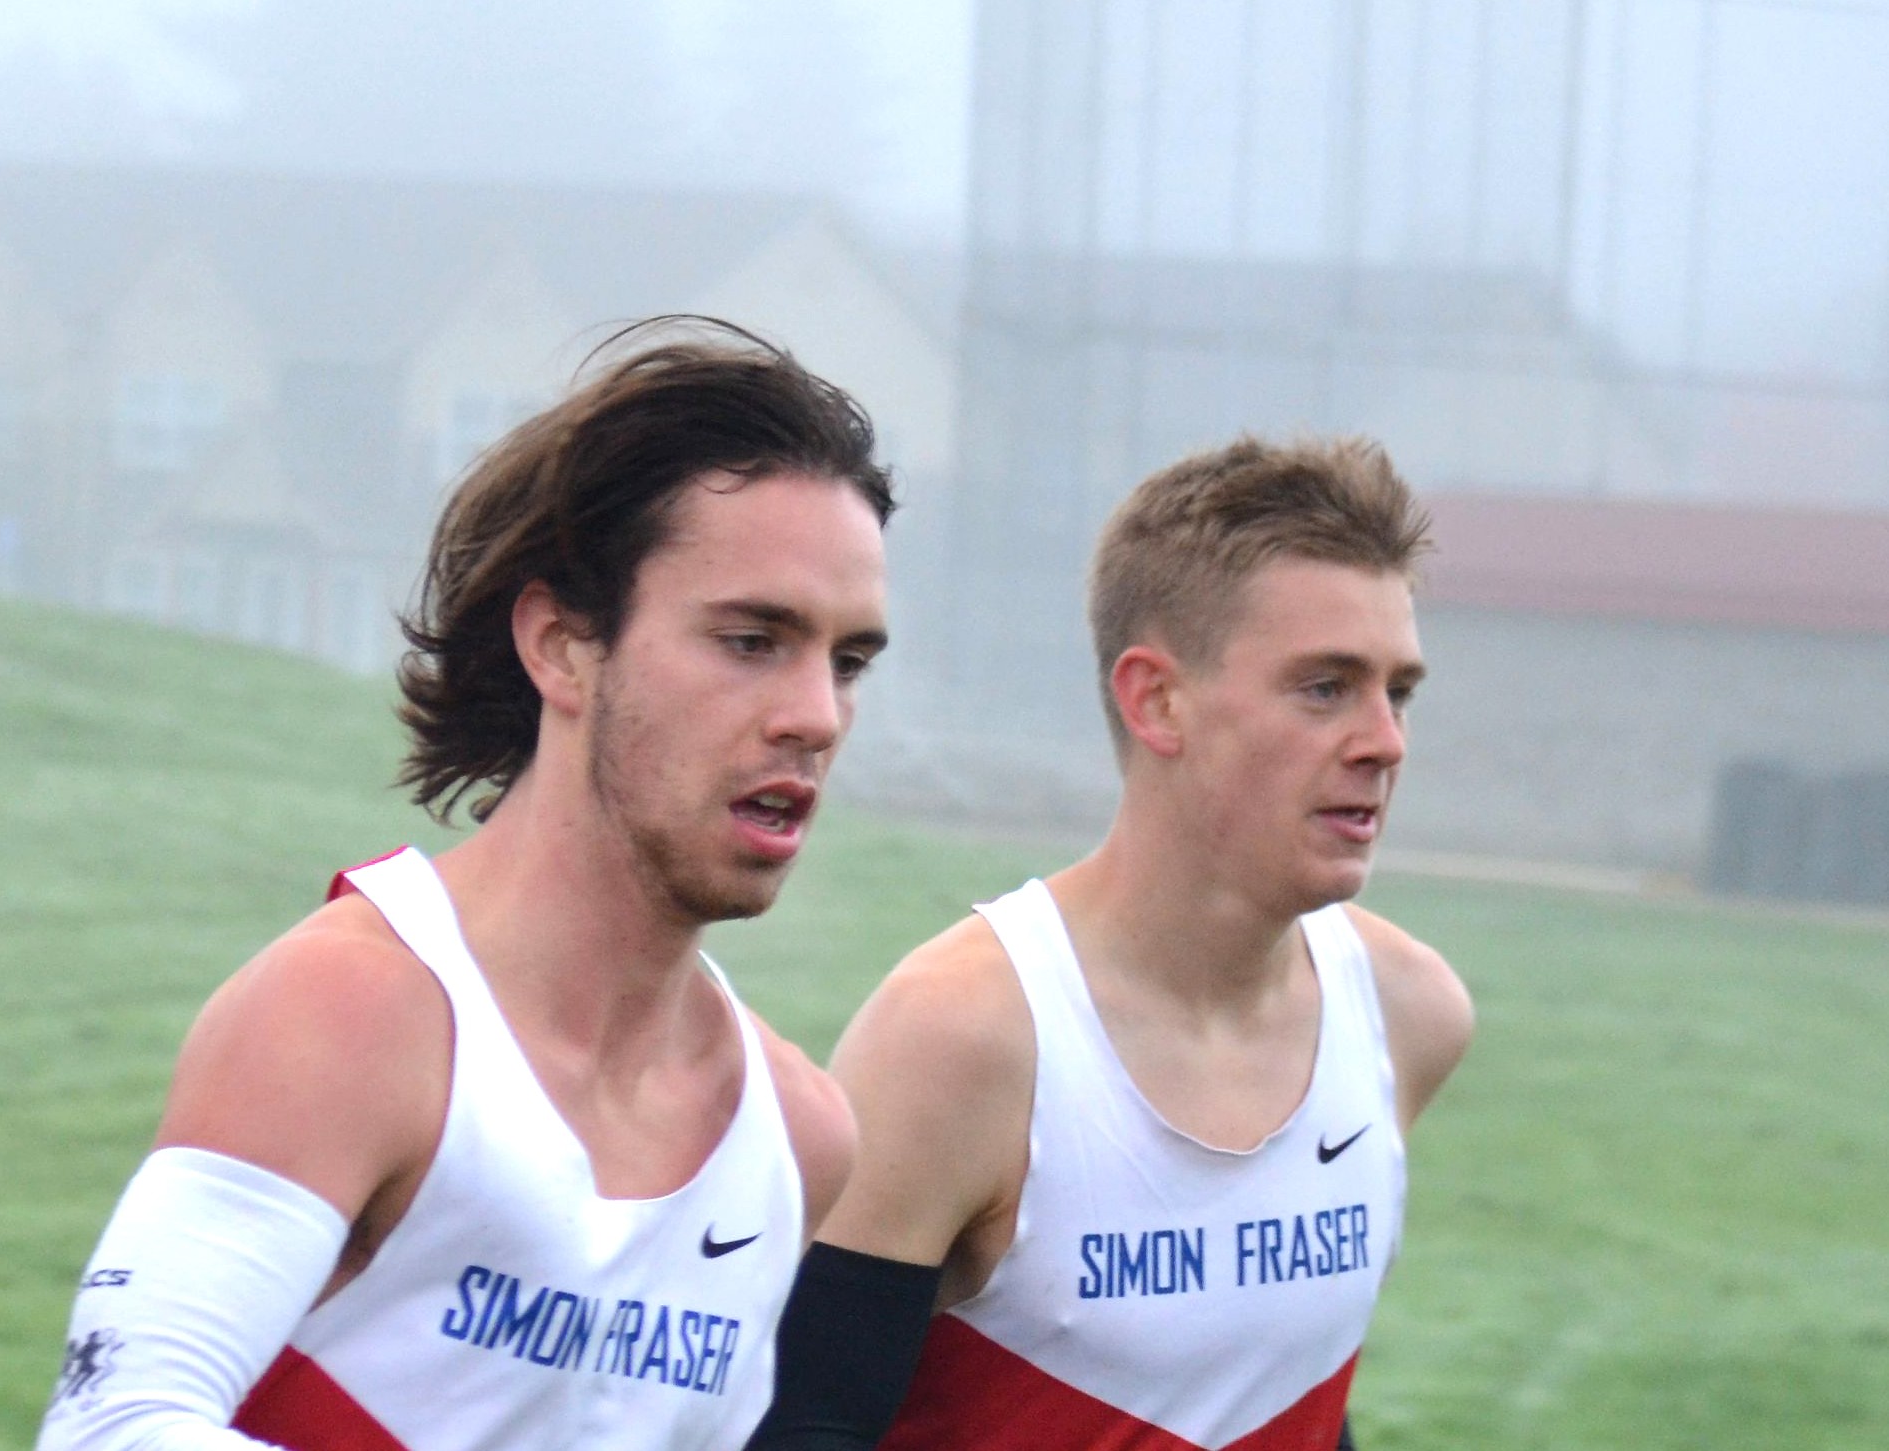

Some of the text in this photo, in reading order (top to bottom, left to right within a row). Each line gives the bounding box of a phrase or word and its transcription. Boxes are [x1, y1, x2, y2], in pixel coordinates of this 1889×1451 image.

[1078, 1204, 1369, 1299] SIMON FRASER
[441, 1264, 740, 1396] SIMON FRASER
